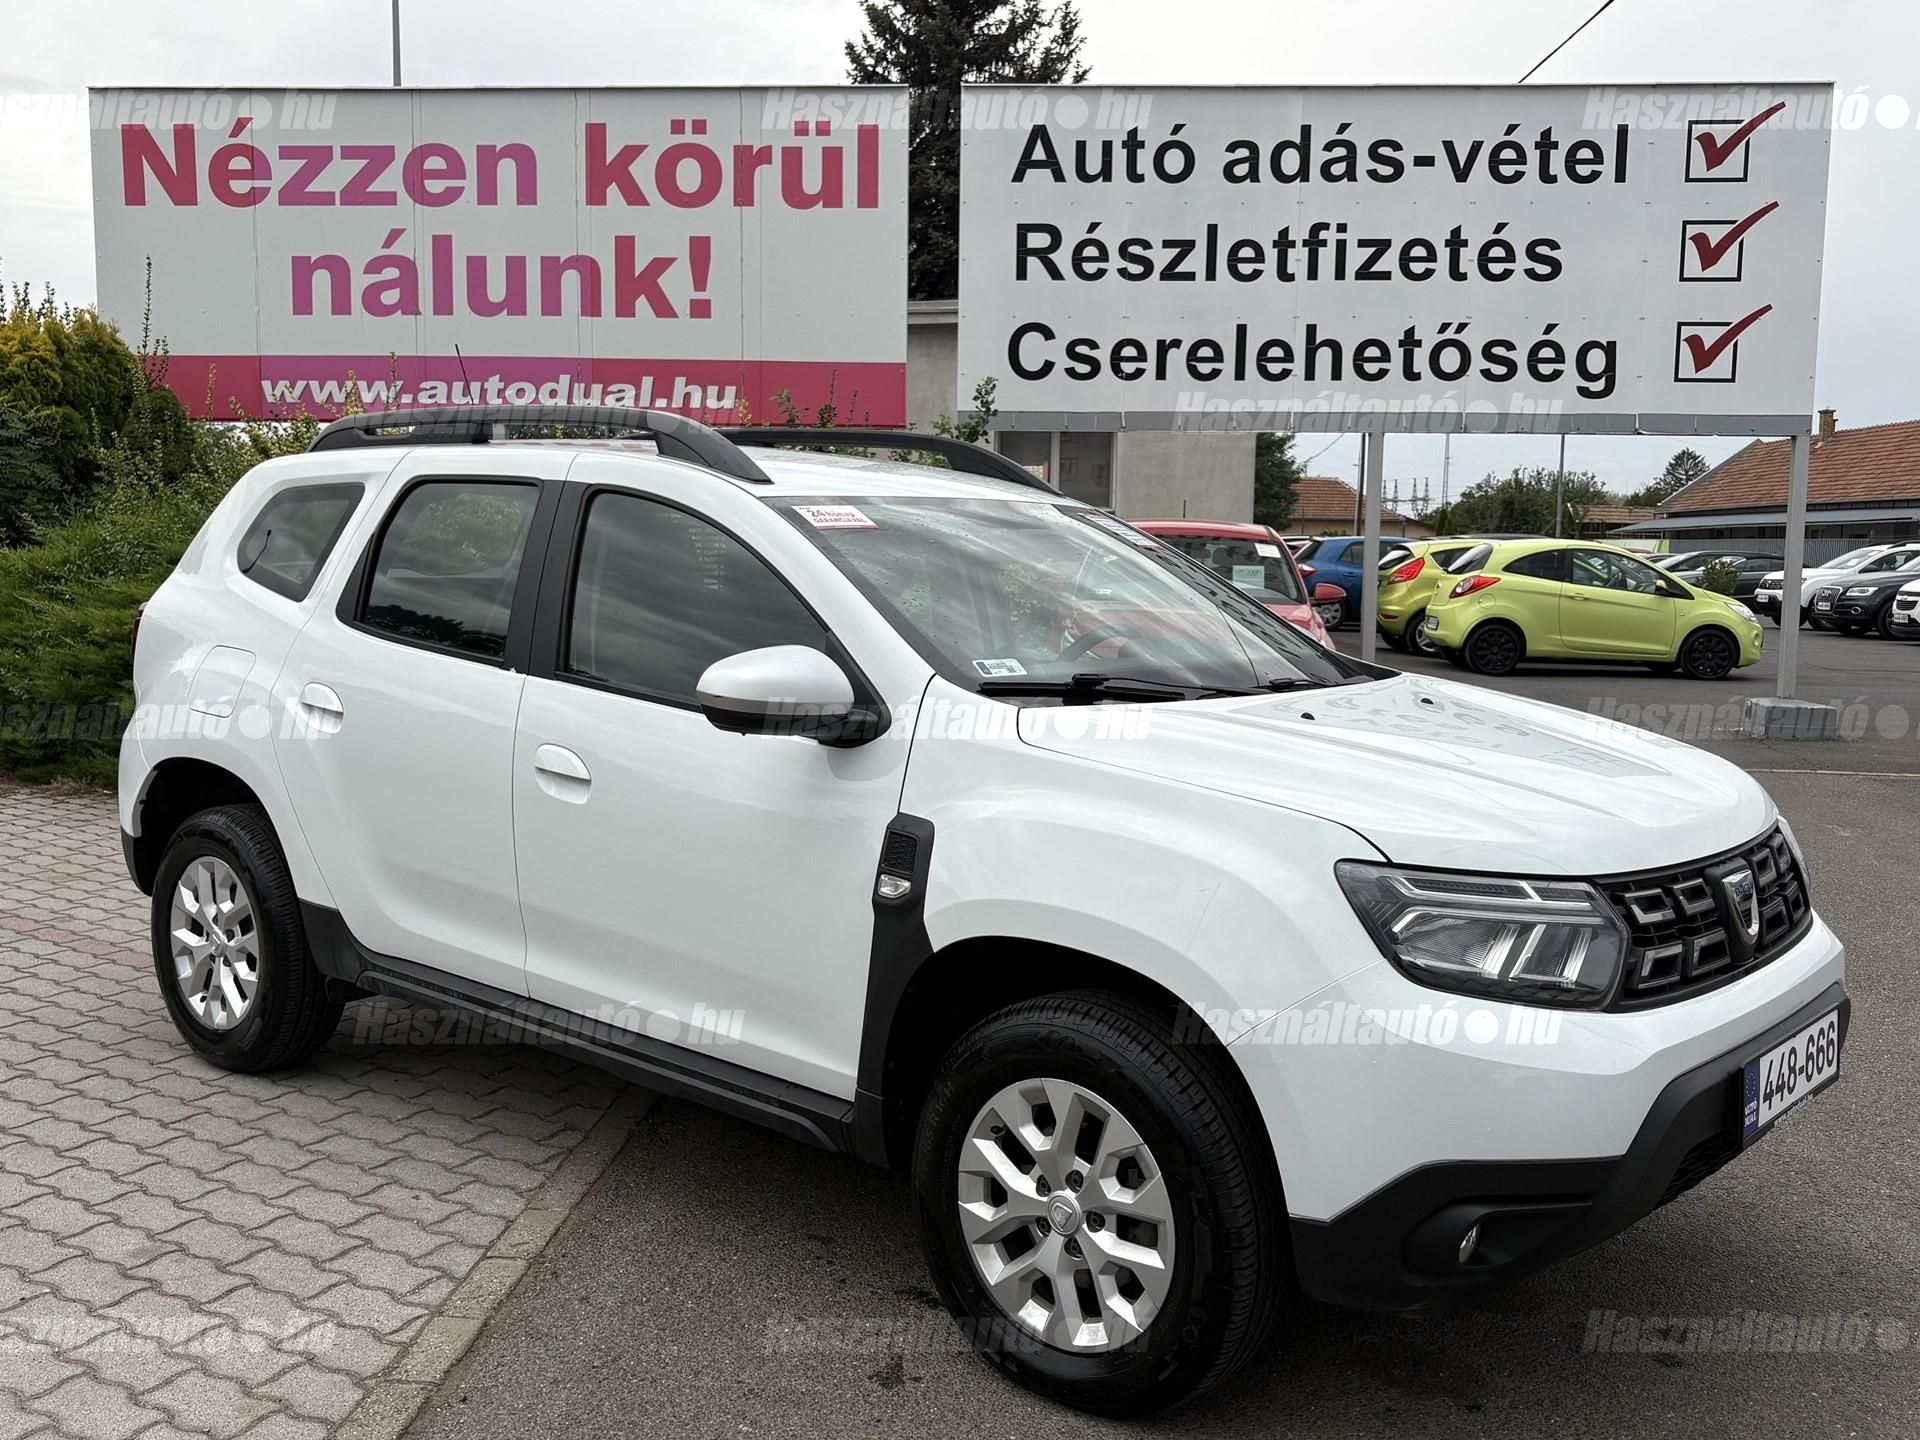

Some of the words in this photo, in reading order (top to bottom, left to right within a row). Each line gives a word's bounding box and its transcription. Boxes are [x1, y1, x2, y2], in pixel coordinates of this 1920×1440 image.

[121, 117, 538, 208] Nézzen
[584, 118, 880, 210] körül
[1010, 122, 1197, 185] Autó
[1222, 121, 1630, 185] adás-vétel
[290, 227, 713, 320] nálunk!
[1015, 221, 1564, 284] Részletfizetés
[260, 373, 738, 409] www.autodual.hu
[1006, 320, 1618, 400] Cserelehetőség
[1761, 1019, 1836, 1111] 448-666
